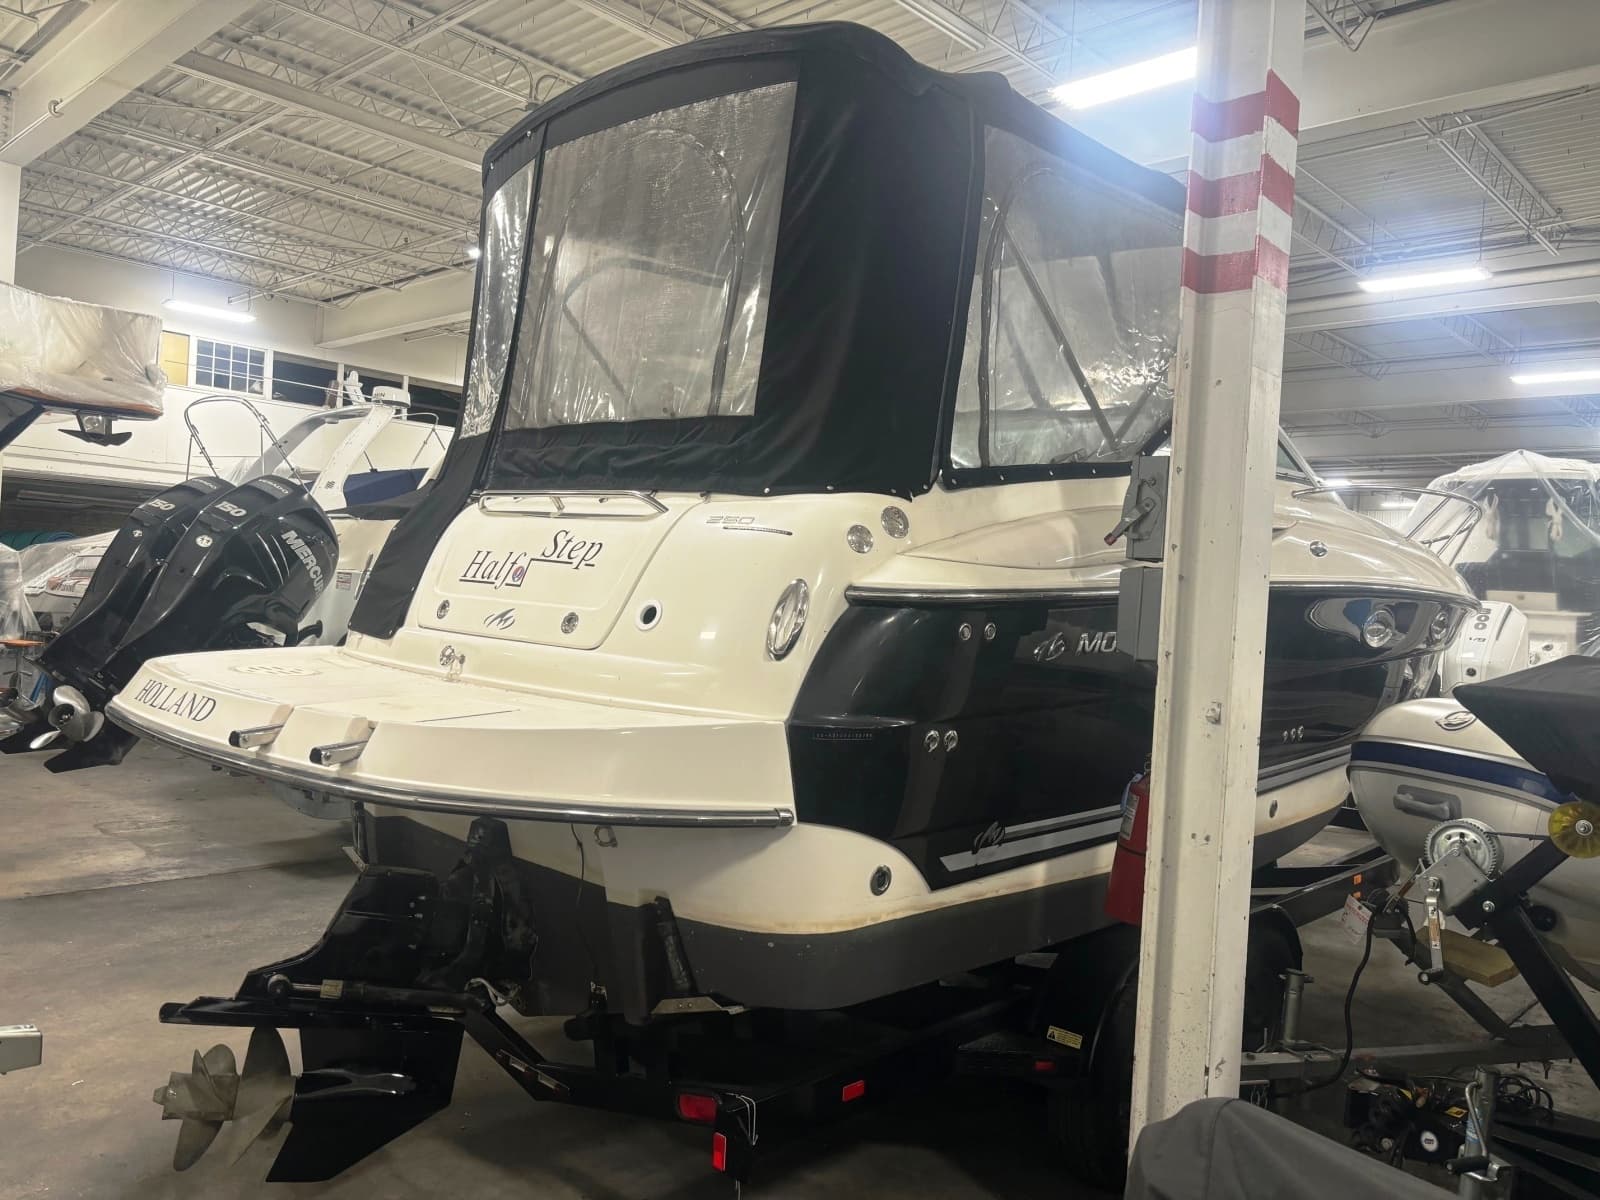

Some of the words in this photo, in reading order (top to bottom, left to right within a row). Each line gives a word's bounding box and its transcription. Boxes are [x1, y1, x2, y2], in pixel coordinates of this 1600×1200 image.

[148, 498, 176, 511] 150
[215, 501, 247, 517] 150
[281, 530, 324, 596] MERCUR
[461, 550, 527, 590] Half
[541, 529, 603, 570] Step
[1075, 631, 1119, 656] MO
[133, 679, 217, 722] HOLLAND
